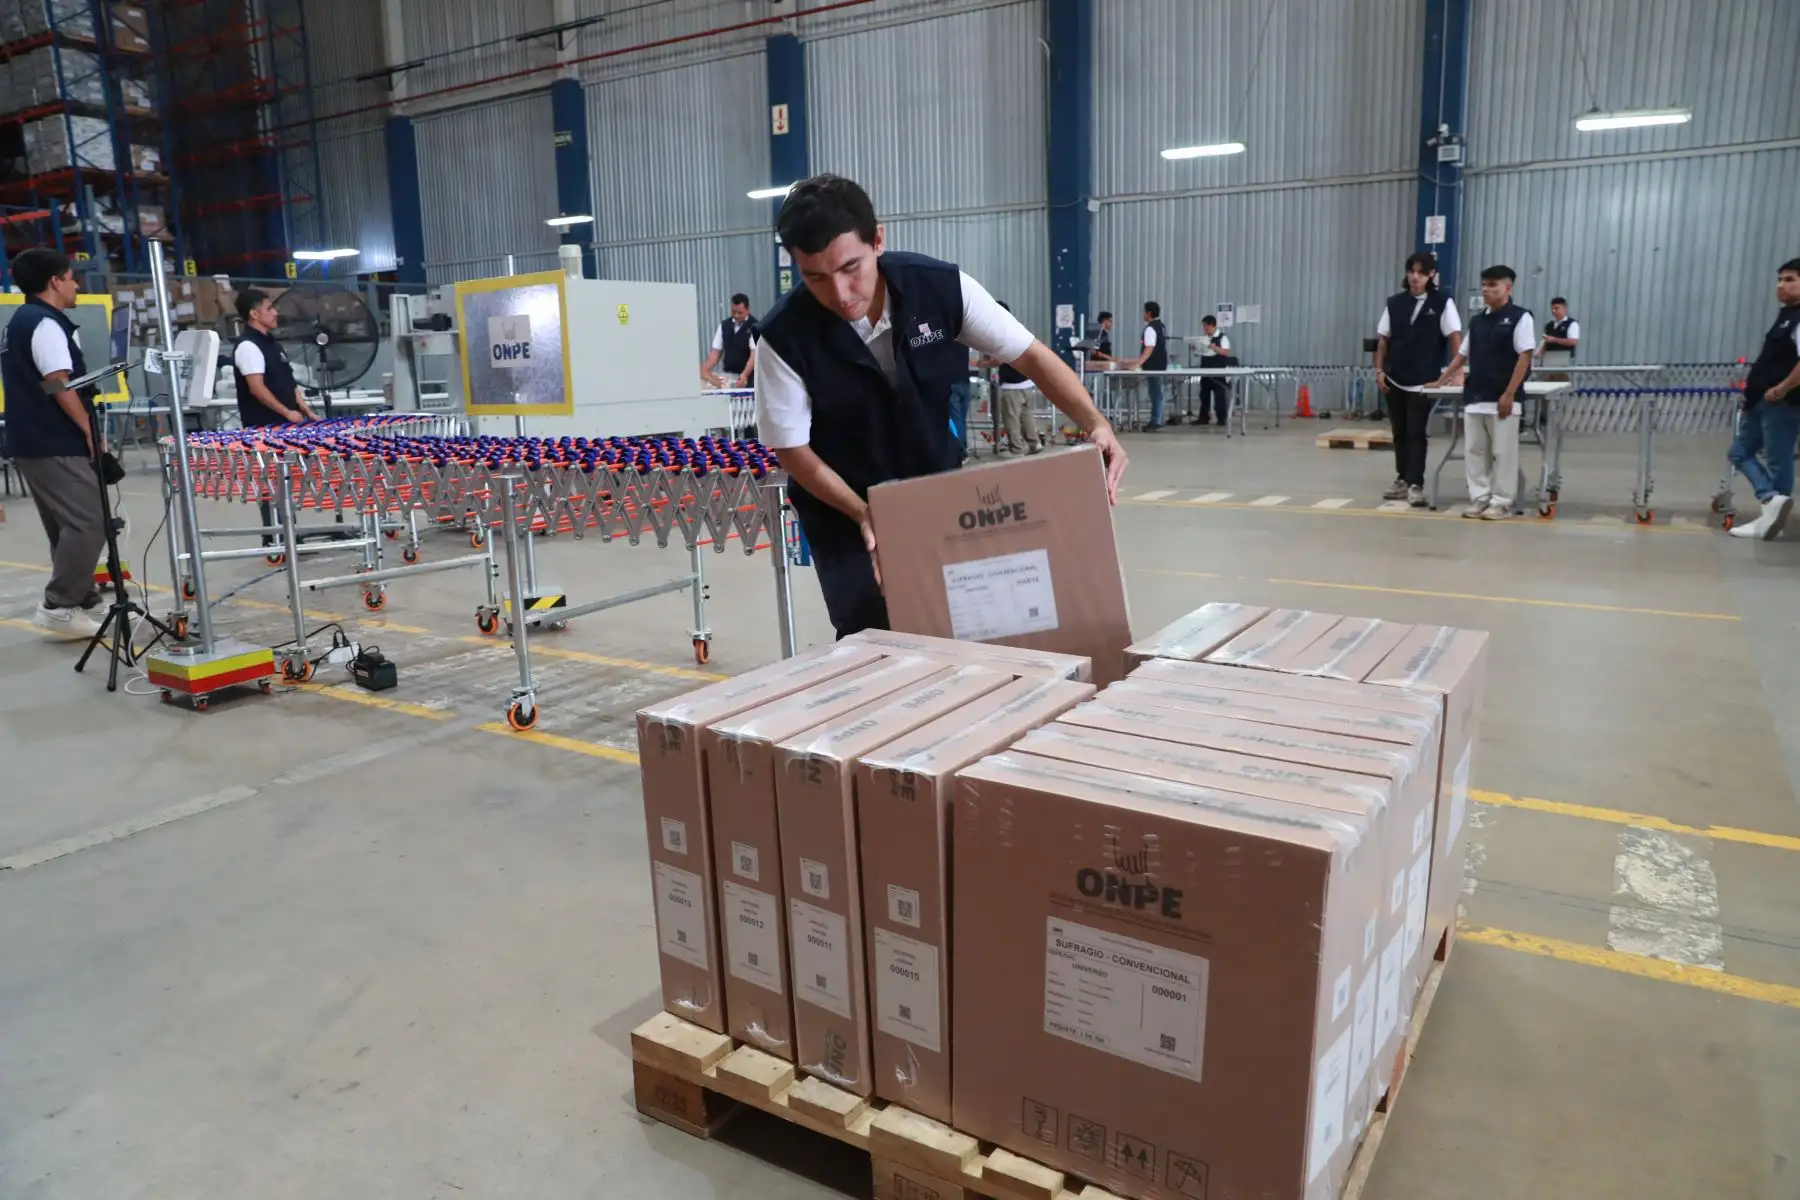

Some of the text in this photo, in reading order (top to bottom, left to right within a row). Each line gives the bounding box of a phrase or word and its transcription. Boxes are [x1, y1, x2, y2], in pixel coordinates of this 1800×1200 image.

[910, 329, 944, 348] ONPE
[493, 341, 531, 361] ONPE
[958, 501, 1028, 530] ONPE
[1076, 868, 1184, 919] ONPE
[739, 914, 765, 929] 000012
[807, 934, 832, 951] 000011
[1055, 938, 1104, 959] SUFRAGIO
[1111, 954, 1191, 985] CONVENCIONAL
[890, 963, 920, 981] 000010
[1151, 984, 1187, 1002] 000001
